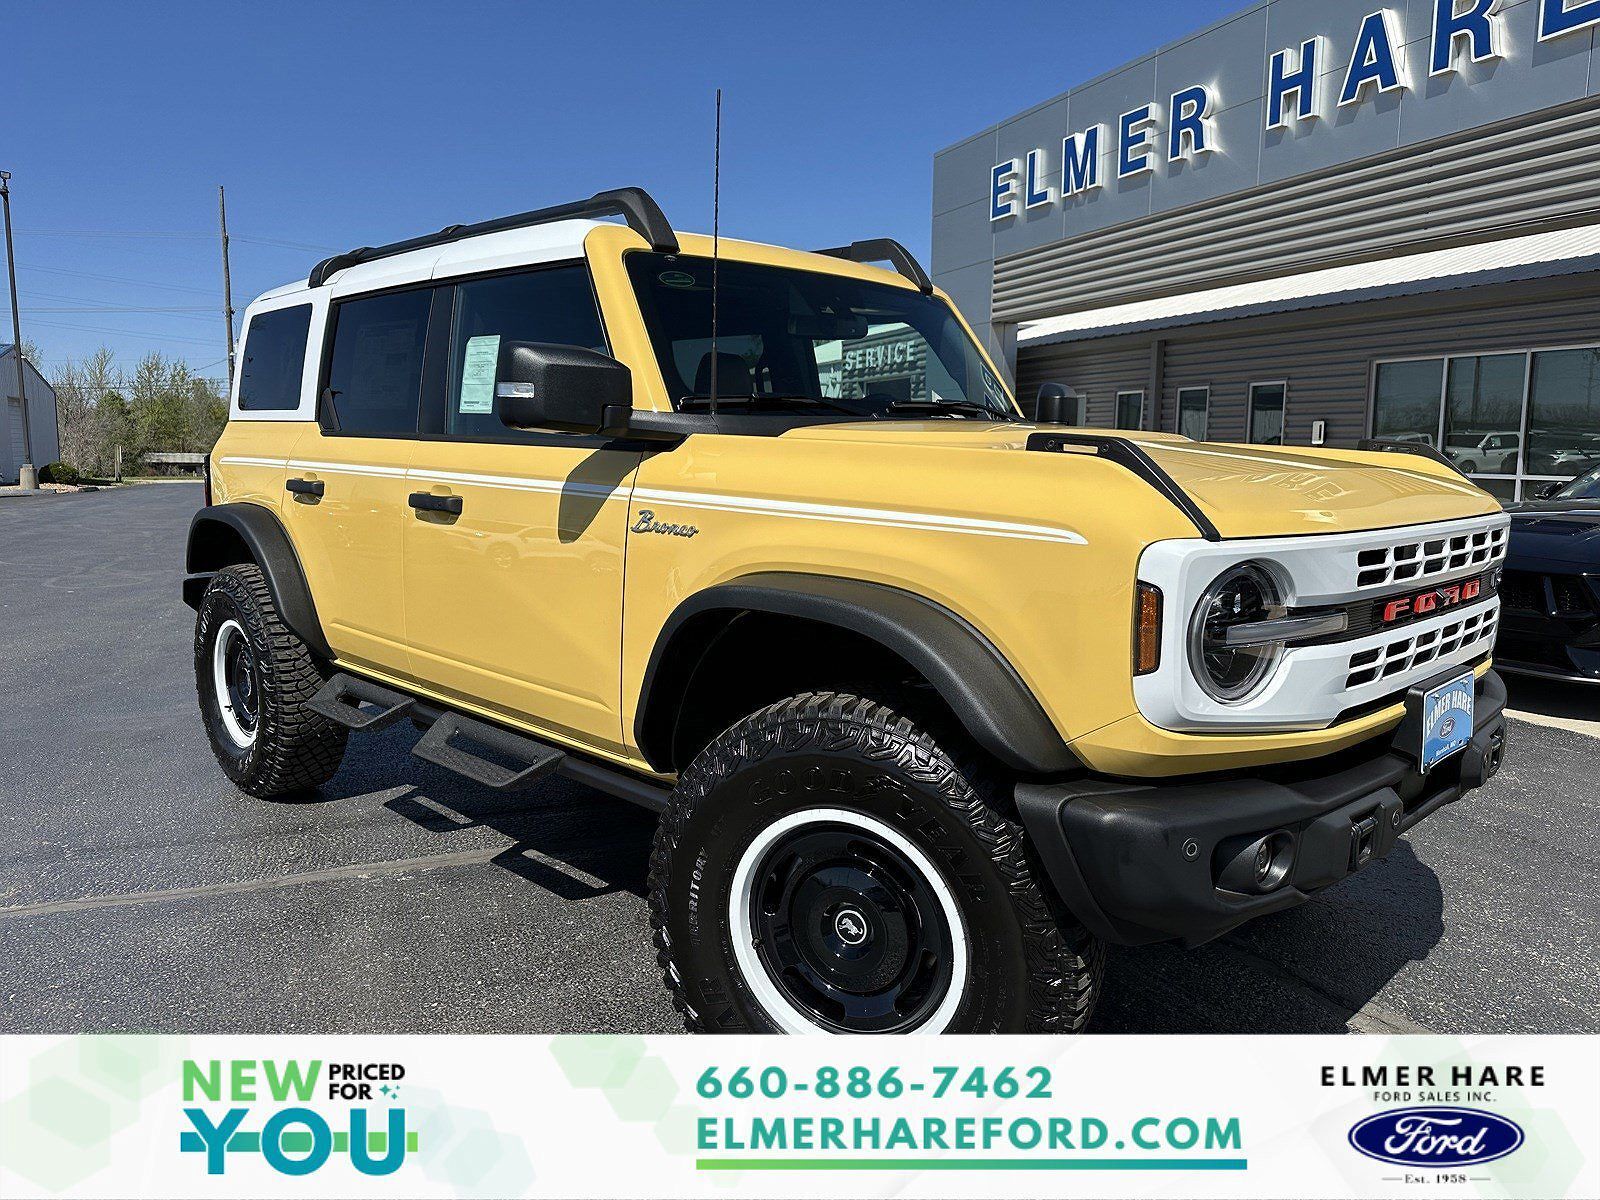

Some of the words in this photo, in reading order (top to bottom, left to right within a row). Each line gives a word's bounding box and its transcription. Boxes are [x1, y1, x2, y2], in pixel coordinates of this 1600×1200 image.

[989, 84, 1218, 222] ELMER
[844, 341, 915, 370] SERVICE
[630, 509, 700, 538] Bronco
[1426, 692, 1451, 738] ELMER
[1452, 690, 1472, 716] HARE
